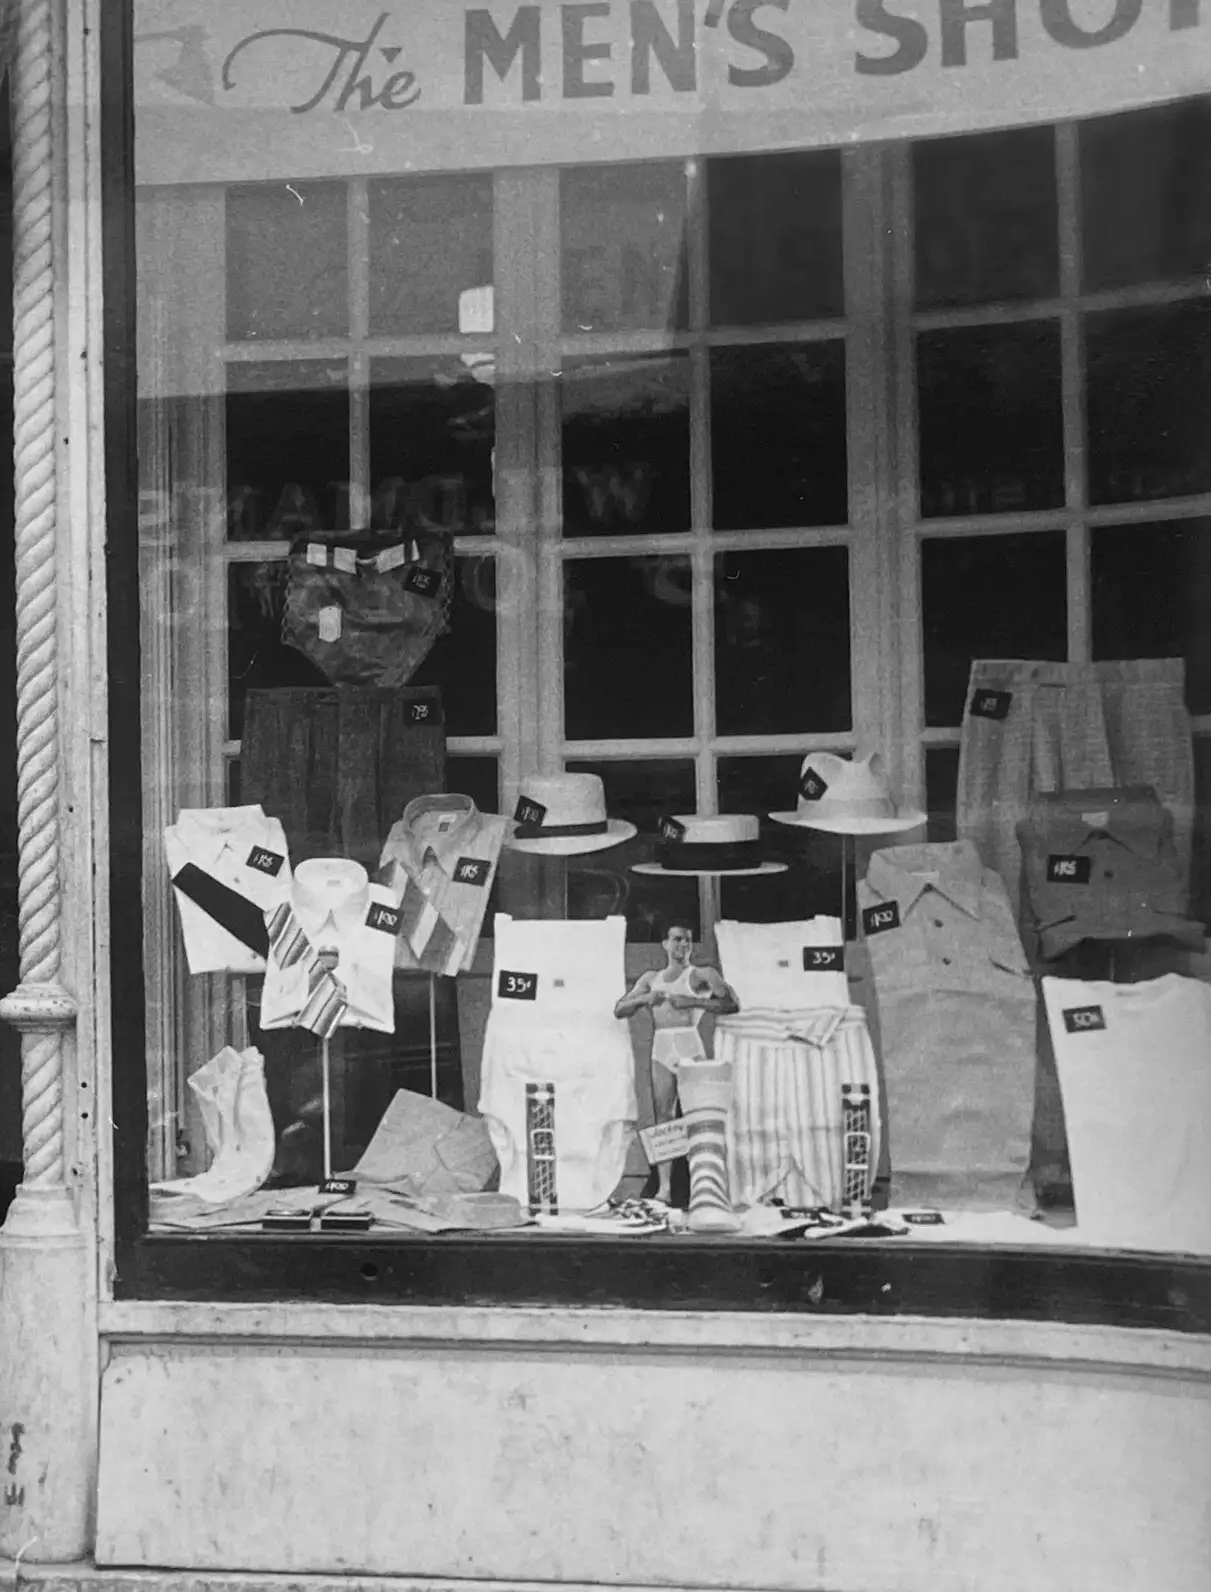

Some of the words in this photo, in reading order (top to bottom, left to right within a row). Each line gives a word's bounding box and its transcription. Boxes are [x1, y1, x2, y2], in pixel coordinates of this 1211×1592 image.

[222, 12, 422, 114] The
[463, 0, 794, 105] MEN'S
[854, 0, 1199, 76] SHO
